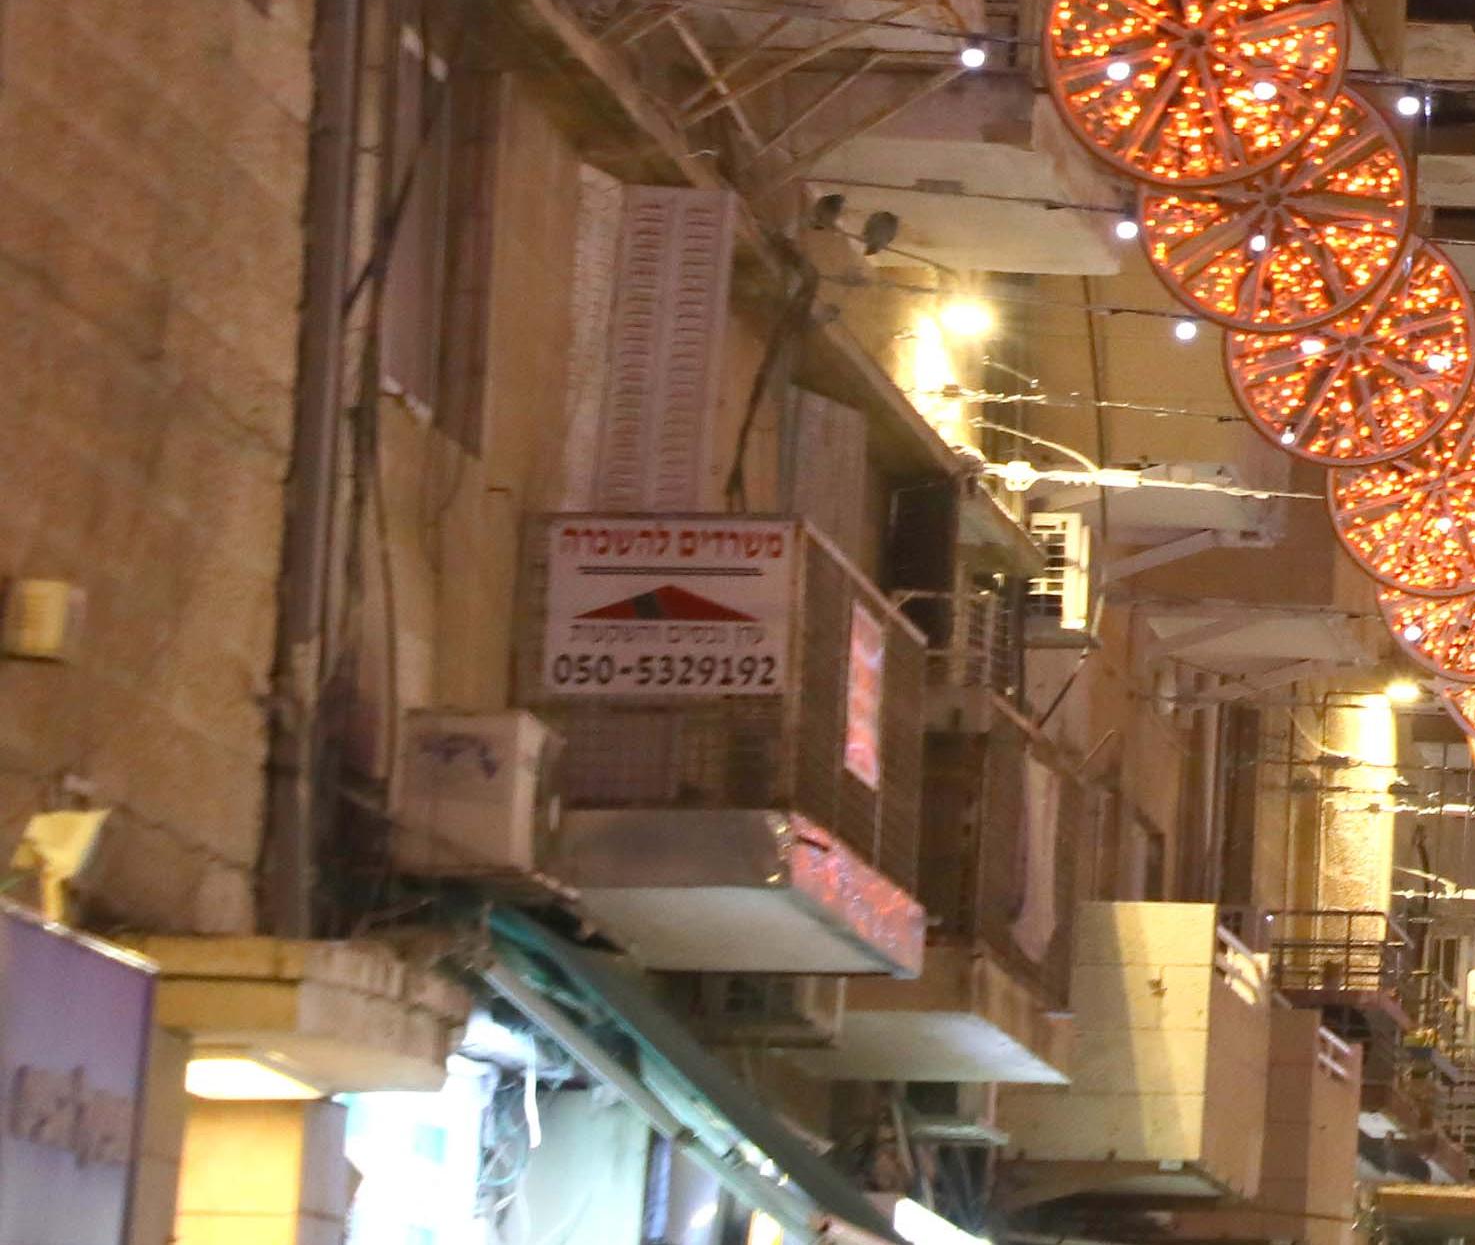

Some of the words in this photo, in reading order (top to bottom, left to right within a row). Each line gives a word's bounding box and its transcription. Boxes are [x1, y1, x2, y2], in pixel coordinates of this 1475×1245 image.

[561, 524, 672, 557] להשכרה
[680, 528, 784, 559] משרדים
[553, 653, 776, 687] 050-5329192
